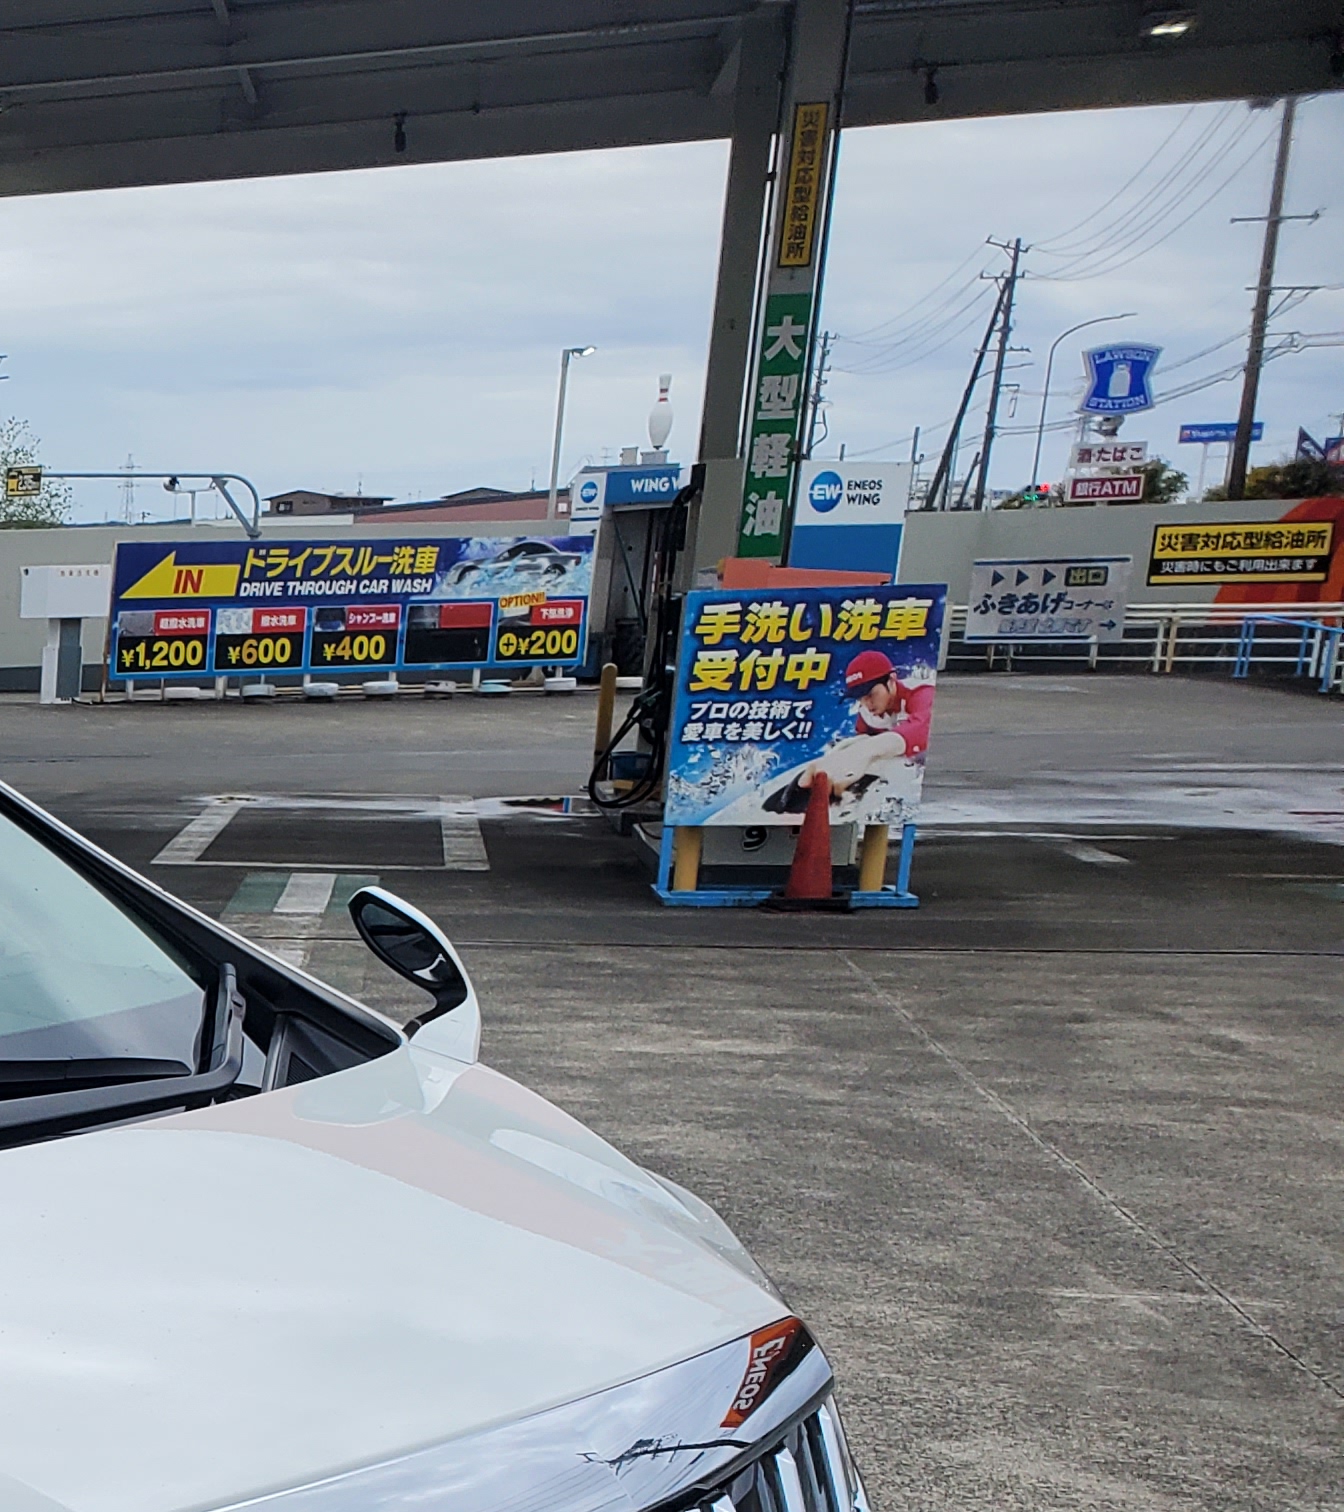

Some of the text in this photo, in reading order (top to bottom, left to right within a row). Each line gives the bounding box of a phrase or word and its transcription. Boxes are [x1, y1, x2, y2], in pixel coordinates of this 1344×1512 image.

[785, 110, 820, 259] 災害対応型給油所
[1088, 394, 1146, 409] STATION
[743, 315, 805, 536] 大型軽油
[630, 477, 670, 494] WING
[847, 479, 883, 491] ENEOS
[1075, 480, 1138, 496] 銀行ATM
[847, 492, 881, 506] WING
[1158, 529, 1328, 552] 災害対応型給油所
[242, 545, 440, 579] ドライブスルー洗車
[1160, 558, 1318, 573] 災害時にもご利用出来ます
[173, 569, 204, 594] IN
[240, 578, 433, 597] DRIVE THROUGH CAR WASH
[1068, 567, 1107, 586] 出口
[499, 591, 545, 609] OPTION!!
[694, 596, 934, 645] 手洗い洗車
[121, 640, 203, 670] ¥1,200
[227, 637, 292, 665] ¥600
[323, 635, 386, 661] ¥400
[689, 647, 831, 692] 受付中
[690, 699, 813, 720] プロの技術で
[681, 720, 812, 743] 愛車を美しく!!
